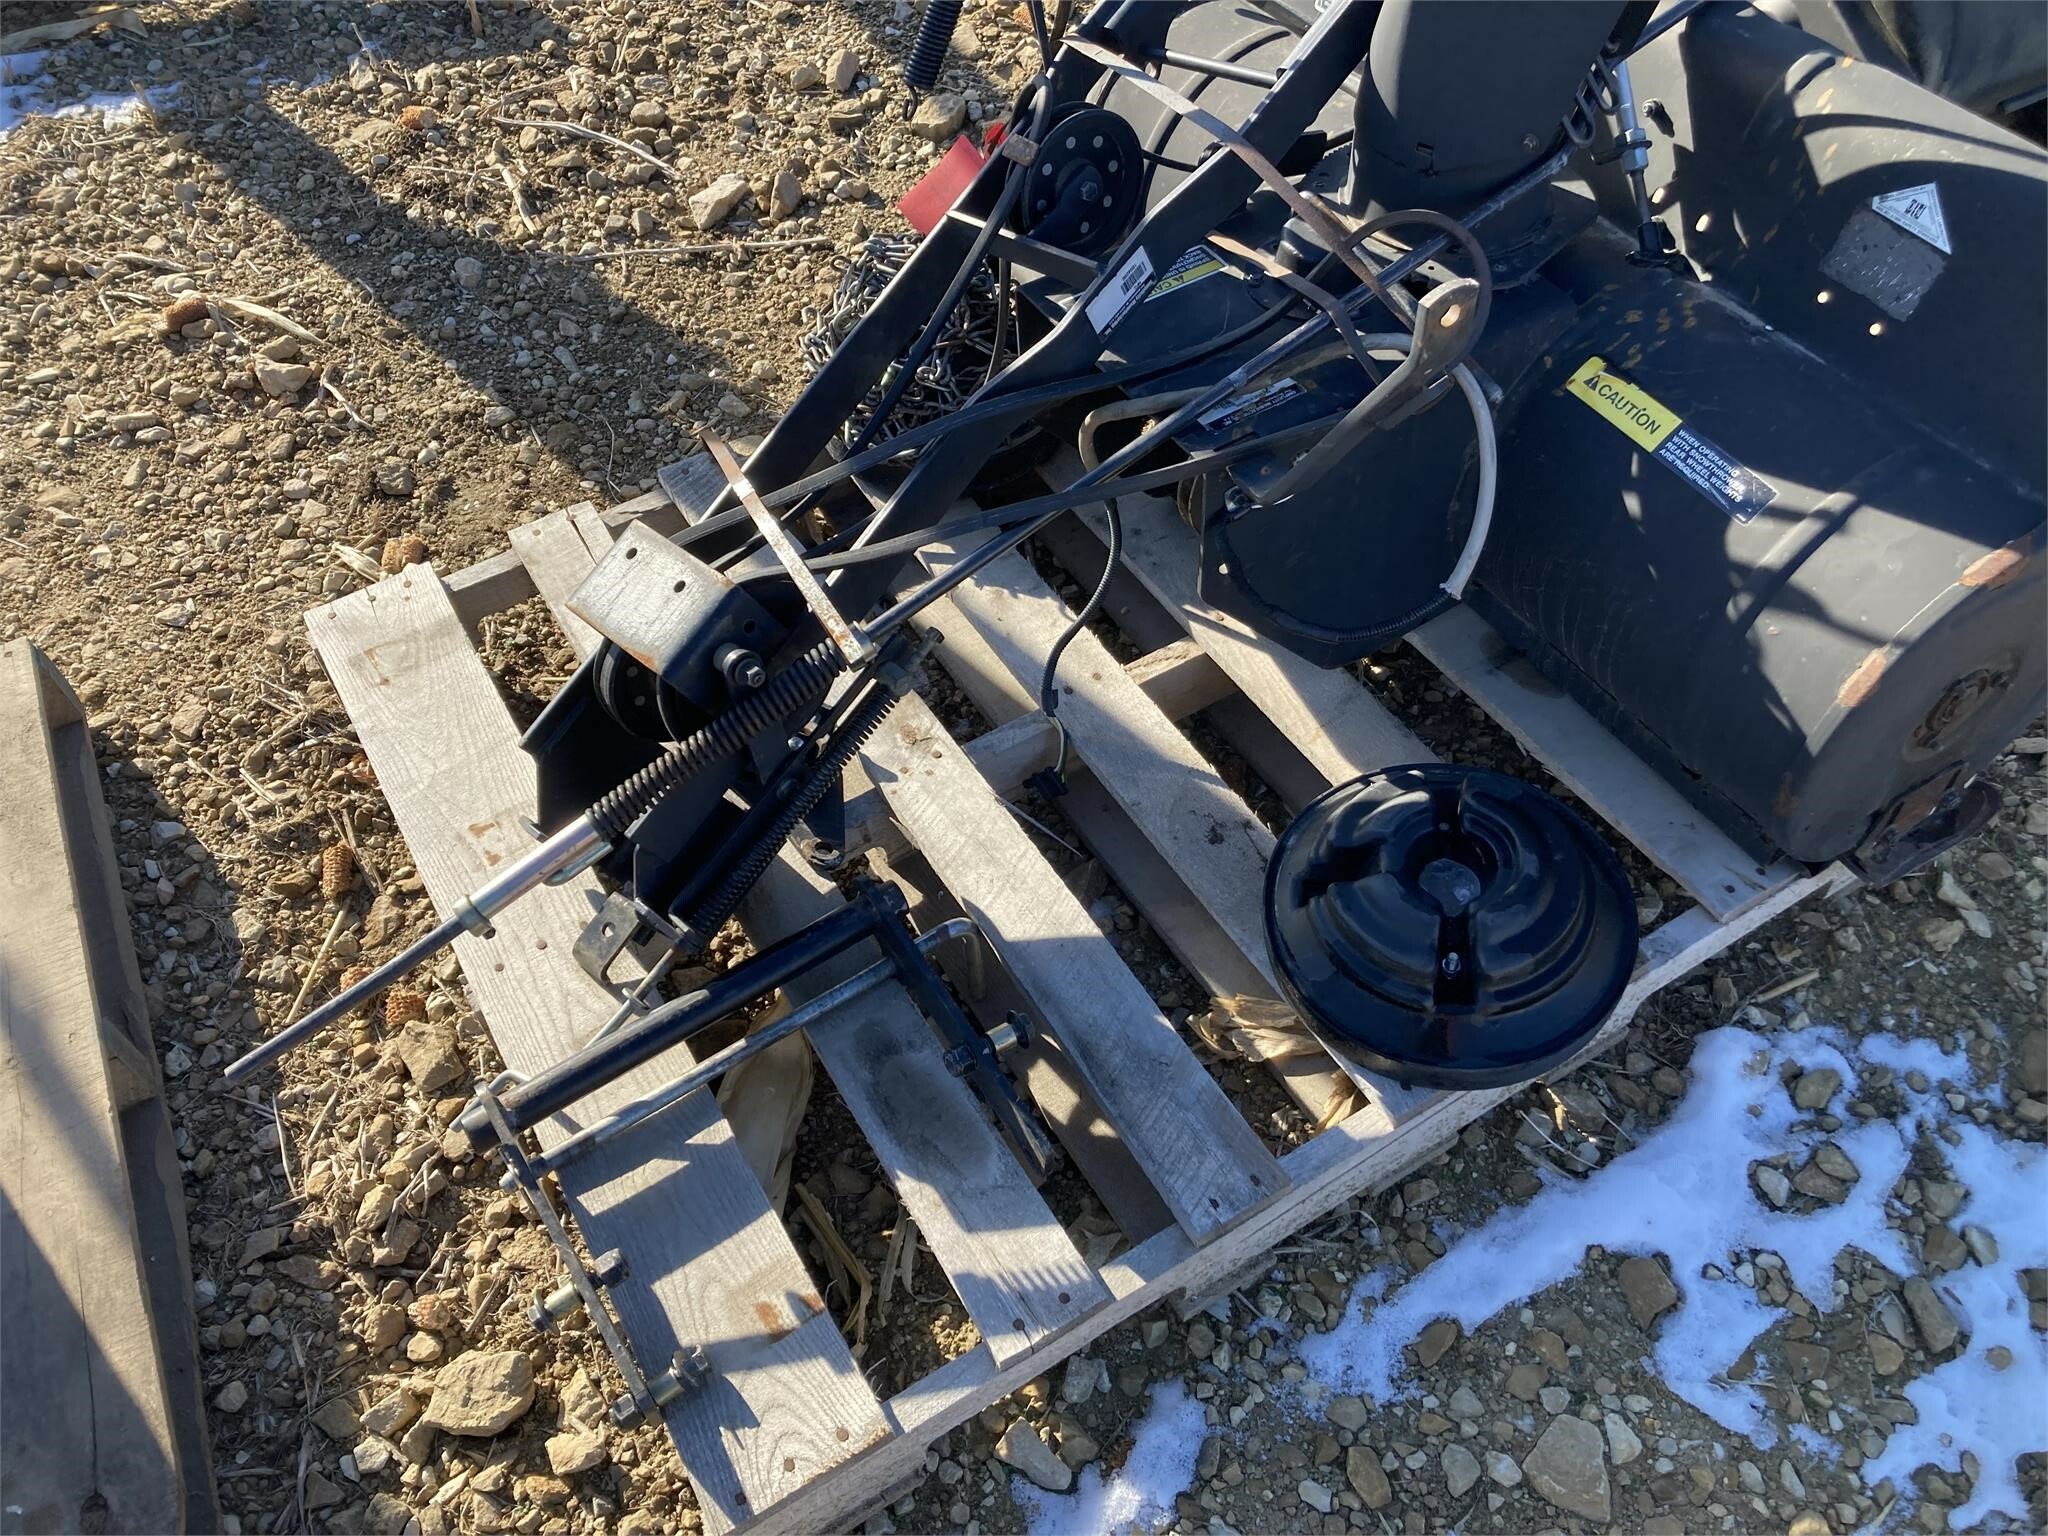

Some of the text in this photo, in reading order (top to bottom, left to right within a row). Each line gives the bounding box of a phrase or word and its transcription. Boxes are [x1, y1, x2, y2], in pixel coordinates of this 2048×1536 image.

[1597, 383, 1661, 434] CAUTION
[1658, 448, 1676, 462] ARE
[1671, 435, 1690, 452] WITH
[1678, 429, 1740, 478] WHEN OPERATING
[1664, 441, 1743, 503] REAR WHEEL WEIGHTS
